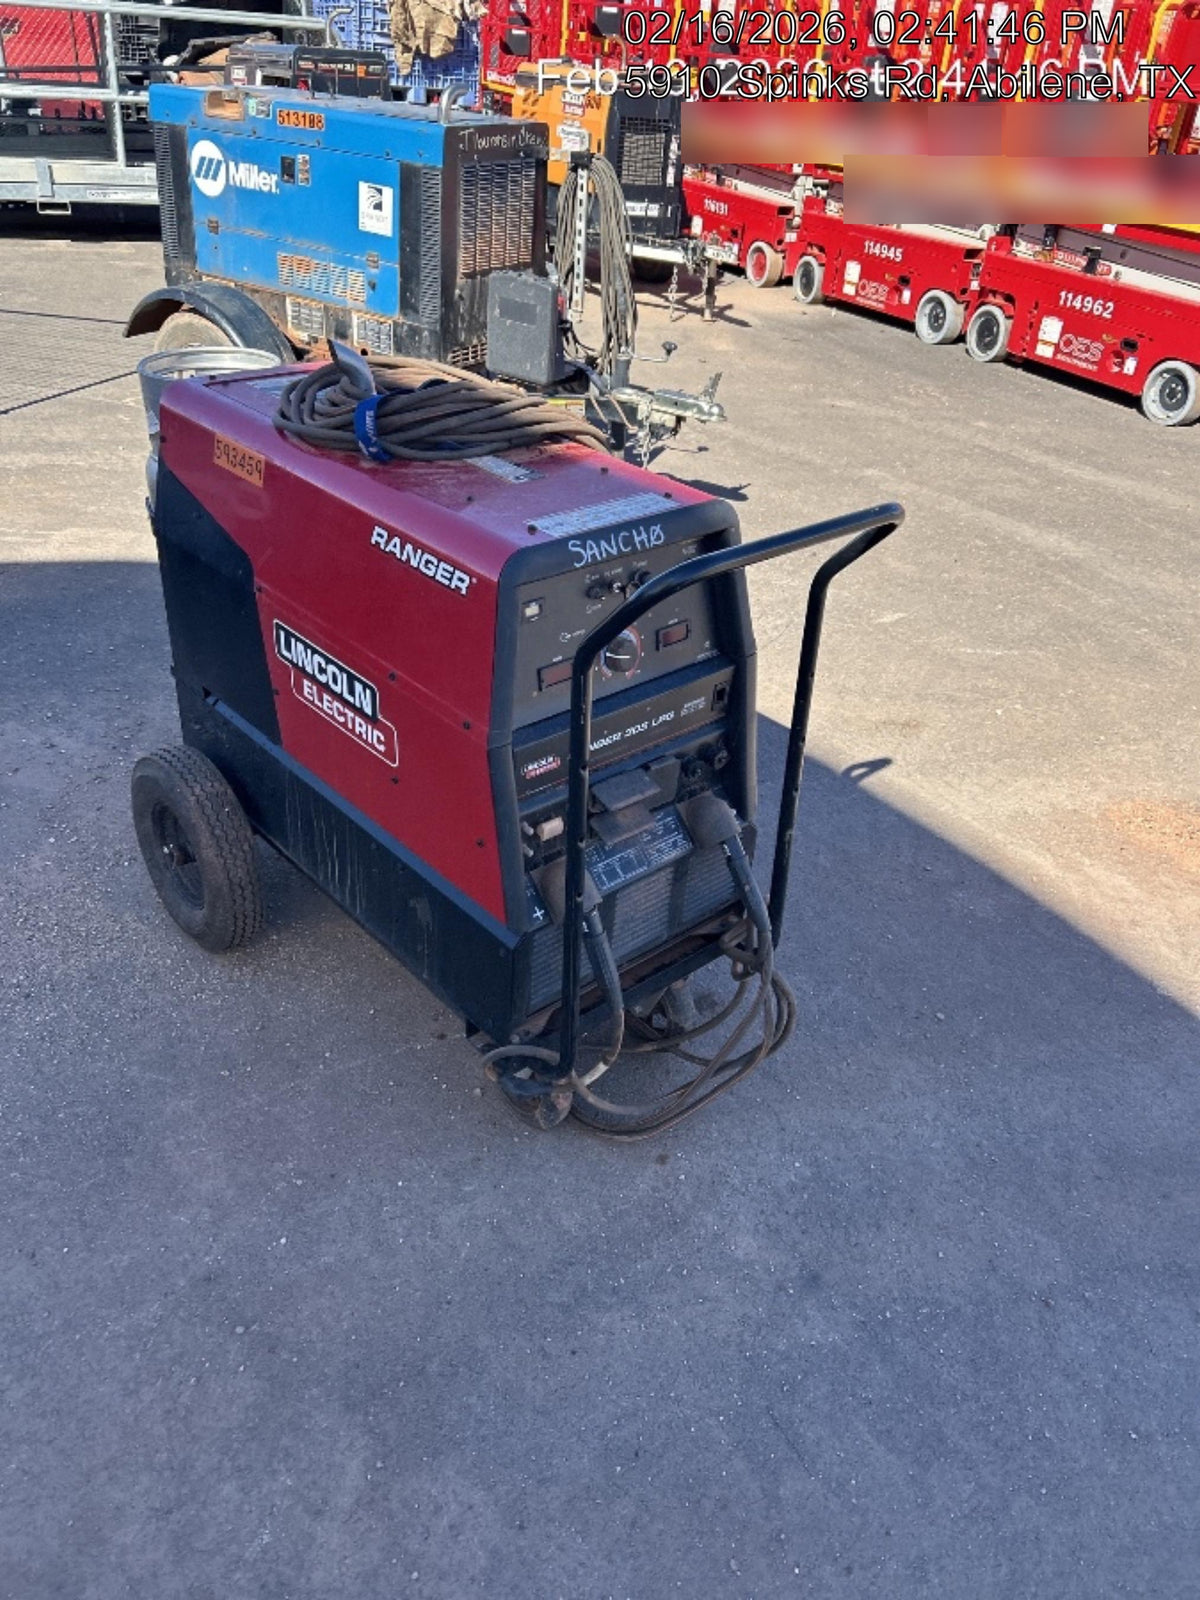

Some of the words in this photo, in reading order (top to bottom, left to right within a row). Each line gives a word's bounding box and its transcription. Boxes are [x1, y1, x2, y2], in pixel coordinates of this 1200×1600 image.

[228, 160, 278, 194] Miller
[864, 240, 904, 262] 114945
[1059, 290, 1114, 319] 114962
[215, 438, 262, 481] 593459
[370, 525, 472, 596] RANGER
[278, 629, 373, 717] LINCOLN
[302, 678, 387, 754] ELECTRIC
